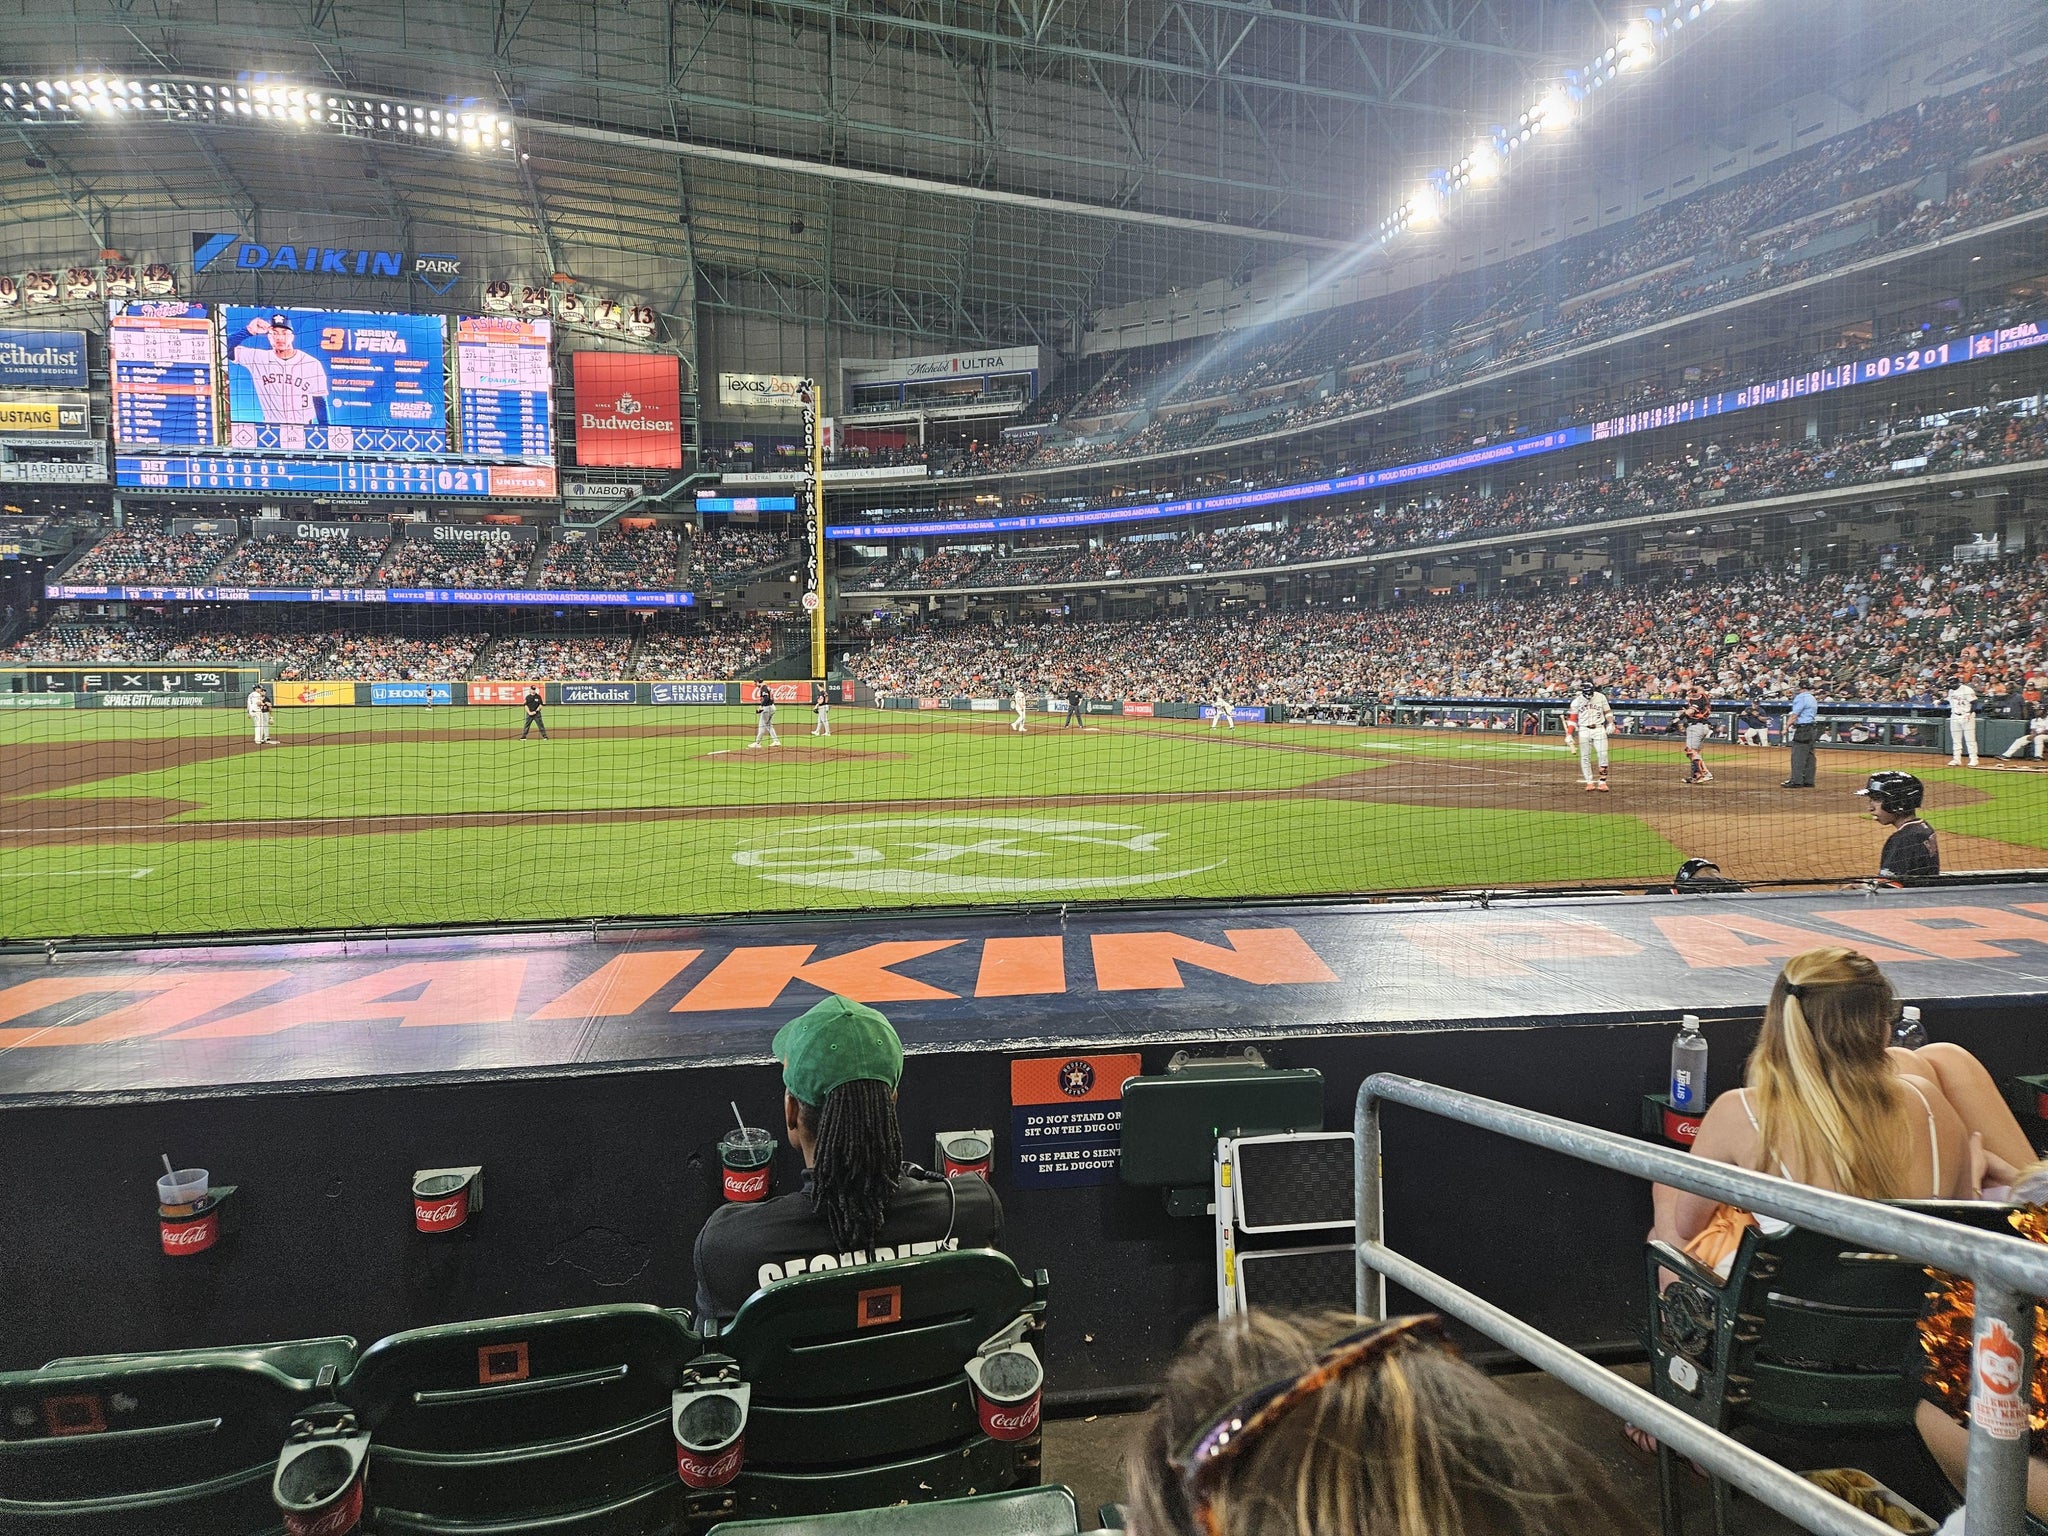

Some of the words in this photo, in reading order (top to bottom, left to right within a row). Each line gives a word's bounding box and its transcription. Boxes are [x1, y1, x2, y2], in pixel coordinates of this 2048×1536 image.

[236, 242, 403, 277] DAIKIN
[415, 259, 461, 274] PARK
[25, 271, 52, 290] 25
[66, 267, 92, 286] 33
[106, 264, 132, 284] 34
[143, 263, 169, 282] 42
[0, 275, 13, 296] 0
[485, 280, 511, 298] 49
[522, 286, 547, 304] 24
[565, 292, 576, 311] 5
[600, 299, 613, 317] 7
[631, 305, 653, 324] 13
[354, 329, 397, 339] JEREMY
[471, 317, 521, 334] ASTROS
[2000, 322, 2040, 342] PEÑA
[320, 327, 345, 351] 3
[355, 337, 407, 353] PEÑA
[0, 347, 79, 366] ethodist
[906, 360, 950, 376] Michelob
[962, 356, 1004, 370] ULTRA
[262, 373, 310, 392] ASTROS
[725, 376, 765, 392] Texas
[771, 377, 798, 395] Bay
[1737, 392, 1747, 406] R
[1766, 386, 1775, 399] H
[1796, 379, 1805, 392] E
[1827, 372, 1835, 386] L
[1843, 364, 1851, 375] 2
[301, 394, 309, 408] 3
[0, 411, 52, 423] USTANG
[60, 411, 85, 425] CAT
[803, 409, 816, 457] ROOT
[17, 464, 95, 481] HARGROVE
[141, 460, 167, 471] DET
[192, 463, 200, 472] 0
[209, 463, 217, 473] 0
[227, 464, 235, 473] 0
[243, 465, 251, 474] 0
[261, 465, 269, 474] 0
[277, 466, 285, 475] 0
[349, 467, 356, 476] 0
[370, 469, 376, 477] 1
[387, 469, 394, 478] 0
[403, 469, 410, 478] 2
[419, 470, 427, 479] 2
[140, 474, 169, 486] HOU
[192, 475, 200, 485] 0
[210, 476, 218, 486] 0
[227, 476, 234, 486] 1
[244, 477, 252, 486] 0
[261, 477, 269, 487] 2
[349, 480, 356, 489] 3
[387, 481, 394, 490] 0
[403, 482, 410, 490] 1
[496, 478, 536, 487] UNITED
[804, 478, 817, 516] THA
[297, 524, 350, 541] Chevy
[433, 526, 512, 542] Silverado
[806, 520, 819, 589] CHIKIN
[194, 588, 206, 600] K
[220, 592, 250, 600] SLIDER
[454, 592, 482, 600] PROUD
[482, 592, 492, 600] TO
[522, 593, 560, 601] HOUSTON
[560, 593, 591, 601] ASTROS
[591, 593, 608, 602] AND
[46, 674, 221, 687] LEXUS
[672, 685, 714, 693] ENERGY
[103, 694, 132, 706] SPACE
[132, 694, 152, 706] CITY
[151, 697, 171, 706] HOME
[171, 697, 203, 706] NETWORK
[568, 689, 631, 701] Methodist
[672, 693, 724, 701] TRANSFER
[751, 684, 799, 701] Ca-Cola
[0, 927, 1340, 1049] DAIKIN
[1062, 1061, 1091, 1073] HOUSTON
[1063, 1085, 1090, 1096] ASTROS
[1028, 1116, 1044, 1126] DO
[1046, 1115, 1069, 1124] NOT
[1071, 1112, 1105, 1123] STAND
[1107, 1111, 1121, 1120] OR
[1025, 1128, 1042, 1137] SIT
[1043, 1127, 1060, 1135] ON
[1061, 1125, 1082, 1134] THE
[1084, 1122, 1121, 1132] DUGOU
[1020, 1154, 1037, 1163] NO
[1039, 1152, 1052, 1162] SE
[1054, 1151, 1080, 1160] PARE
[1082, 1150, 1091, 1158] O
[1093, 1148, 1122, 1158] SIENT
[1039, 1164, 1053, 1173] EN
[1055, 1163, 1069, 1172] EL
[1071, 1160, 1115, 1171] DUGOUT
[724, 1174, 766, 1194] Coca-Cola
[415, 1201, 459, 1222] Coca-Cola
[161, 1223, 209, 1246] Coca-Cola
[1677, 1366, 1687, 1381] 5
[681, 1450, 742, 1478] Coca-Cola
